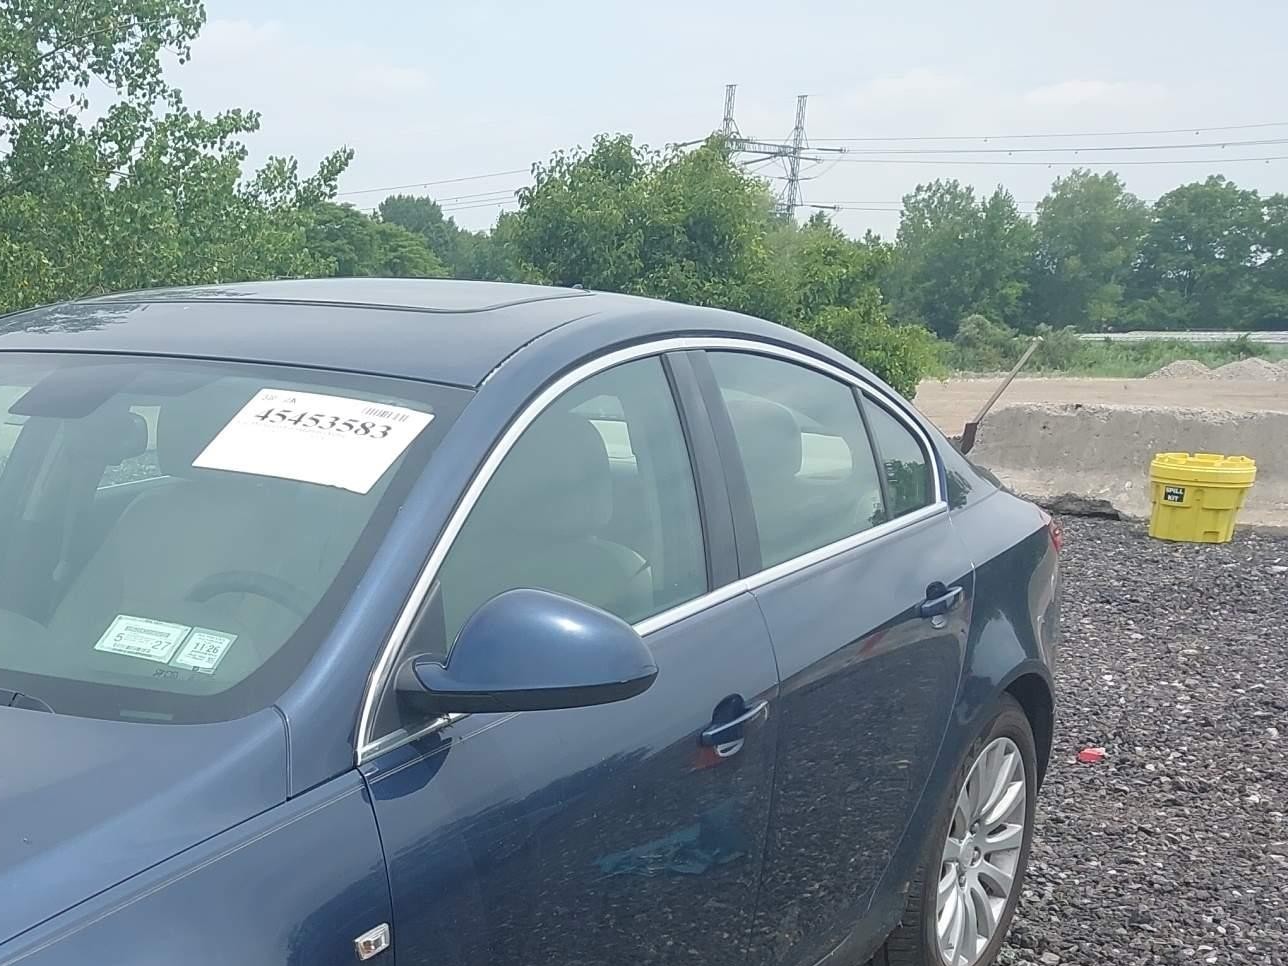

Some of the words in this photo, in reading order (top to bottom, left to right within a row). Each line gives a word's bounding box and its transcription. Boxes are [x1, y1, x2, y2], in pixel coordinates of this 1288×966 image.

[254, 407, 393, 440] 45453583
[1167, 494, 1180, 502] KIT
[113, 632, 125, 642] 5
[151, 640, 172, 650] 27
